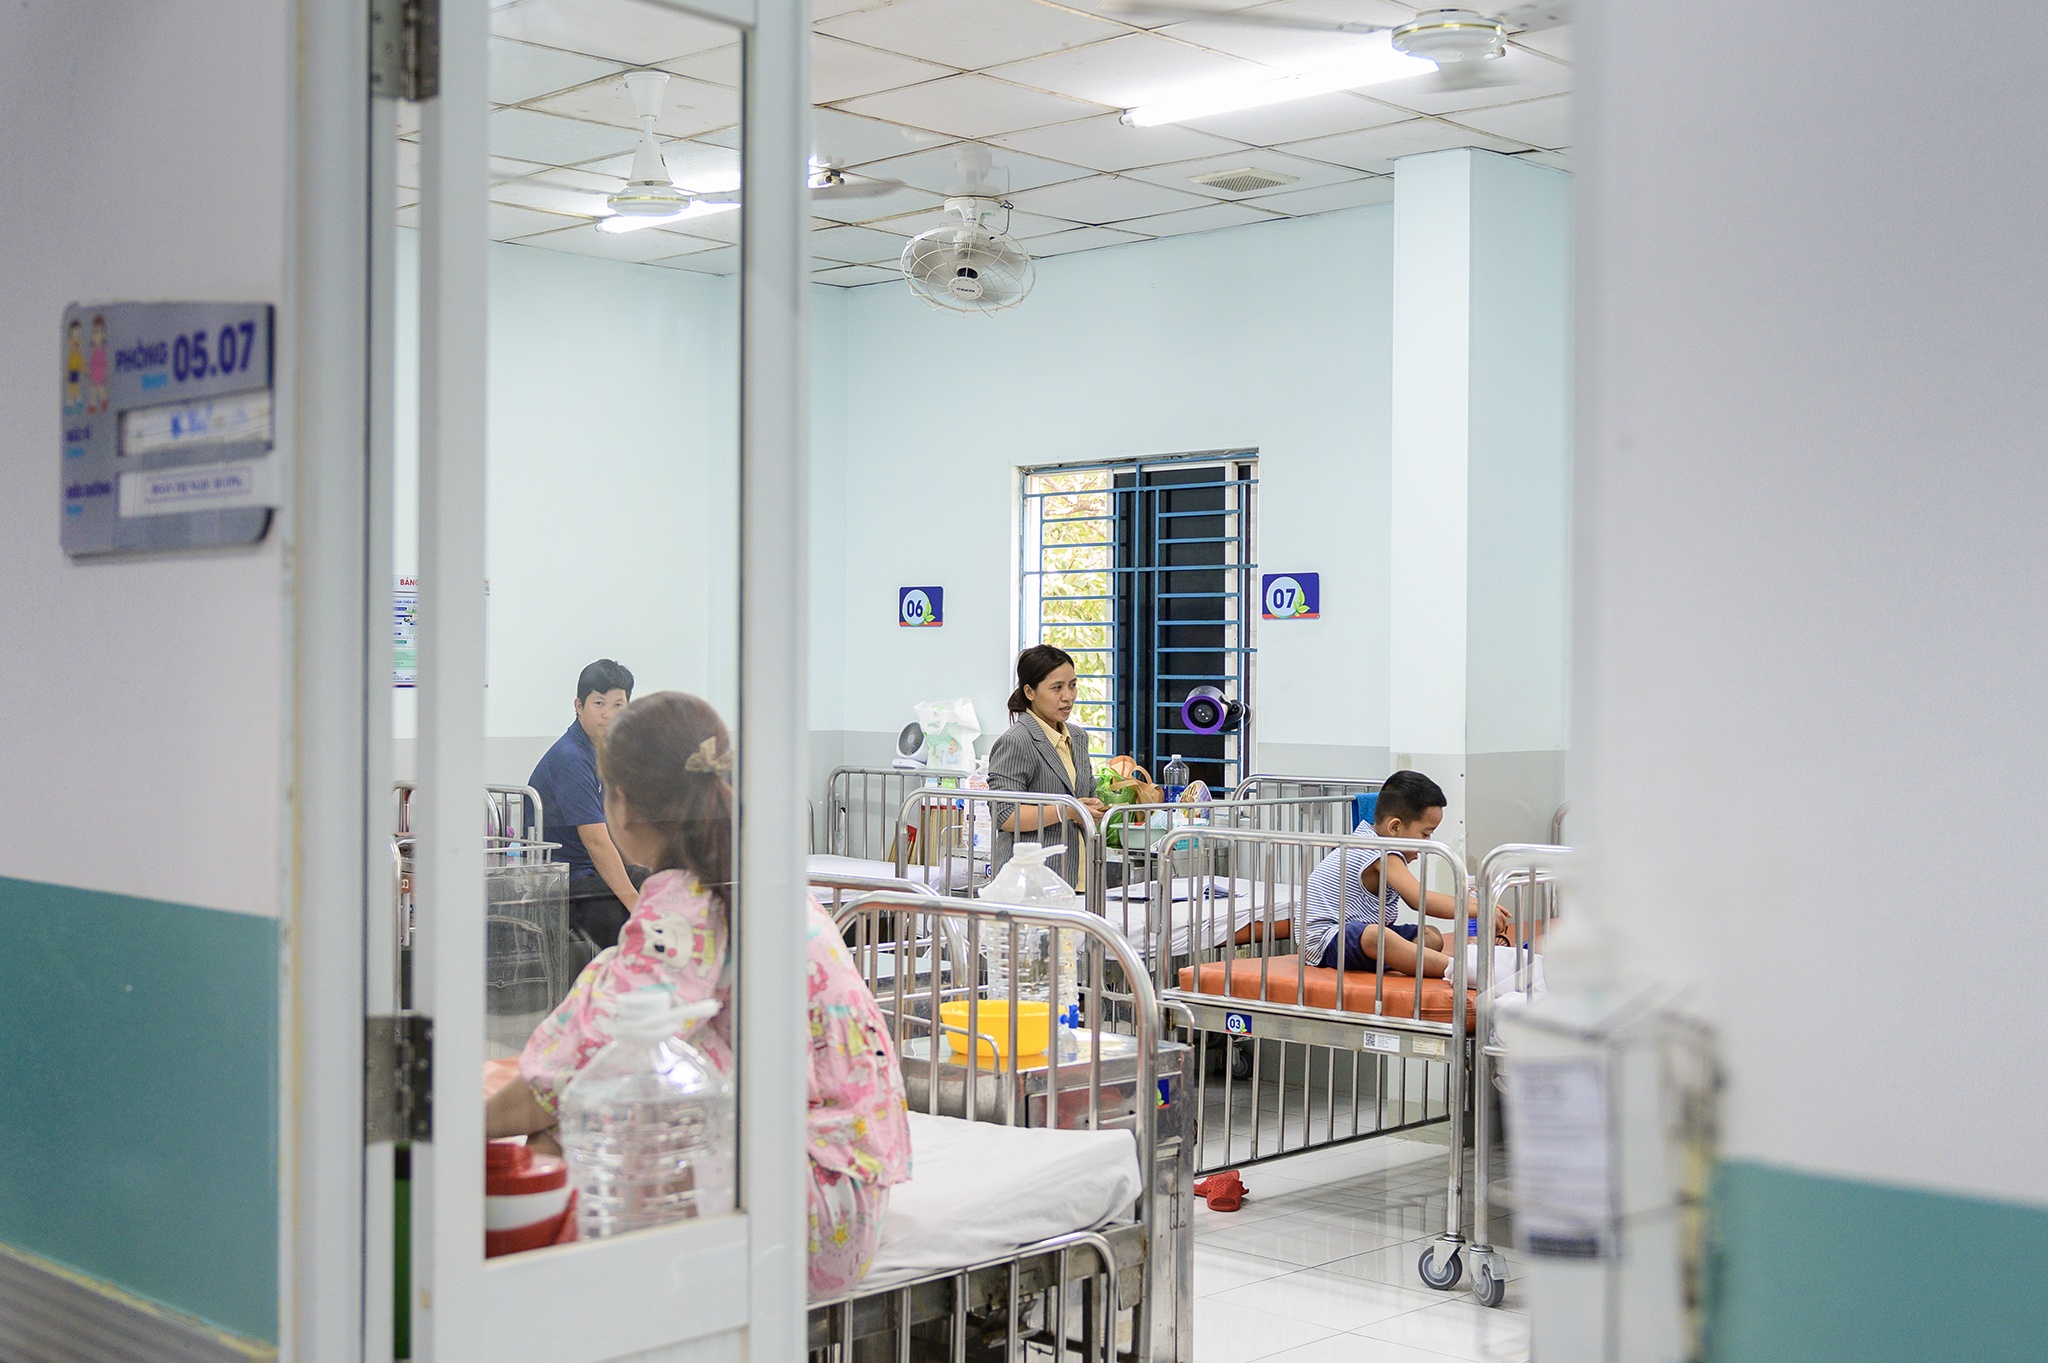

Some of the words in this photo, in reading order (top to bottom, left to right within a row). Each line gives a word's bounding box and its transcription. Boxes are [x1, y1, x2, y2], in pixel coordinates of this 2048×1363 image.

[172, 320, 257, 382] 05.07
[907, 599, 923, 618] 06
[1273, 588, 1296, 609] 07
[1229, 1018, 1241, 1030] 03
